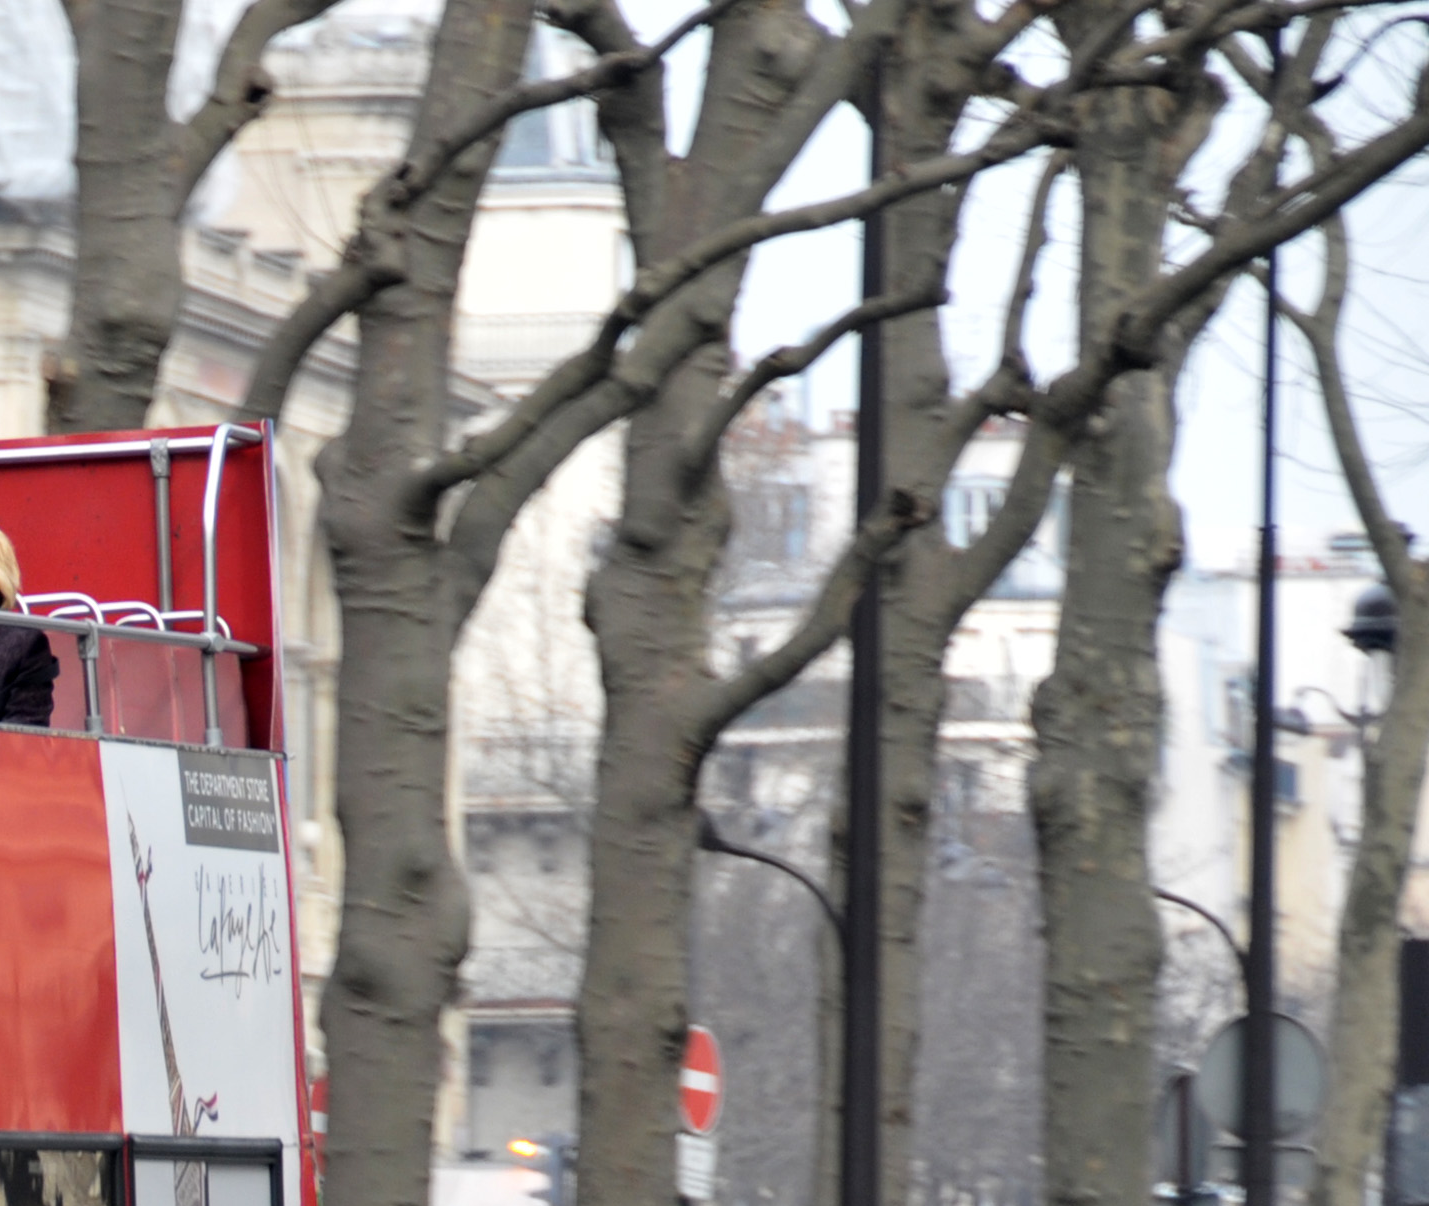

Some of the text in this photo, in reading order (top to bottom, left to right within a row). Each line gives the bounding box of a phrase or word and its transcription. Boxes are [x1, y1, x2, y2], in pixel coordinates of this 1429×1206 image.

[184, 770, 269, 803] THE DEPARTMENT STORE
[188, 803, 223, 831] CAPITAL
[224, 806, 235, 832] OF
